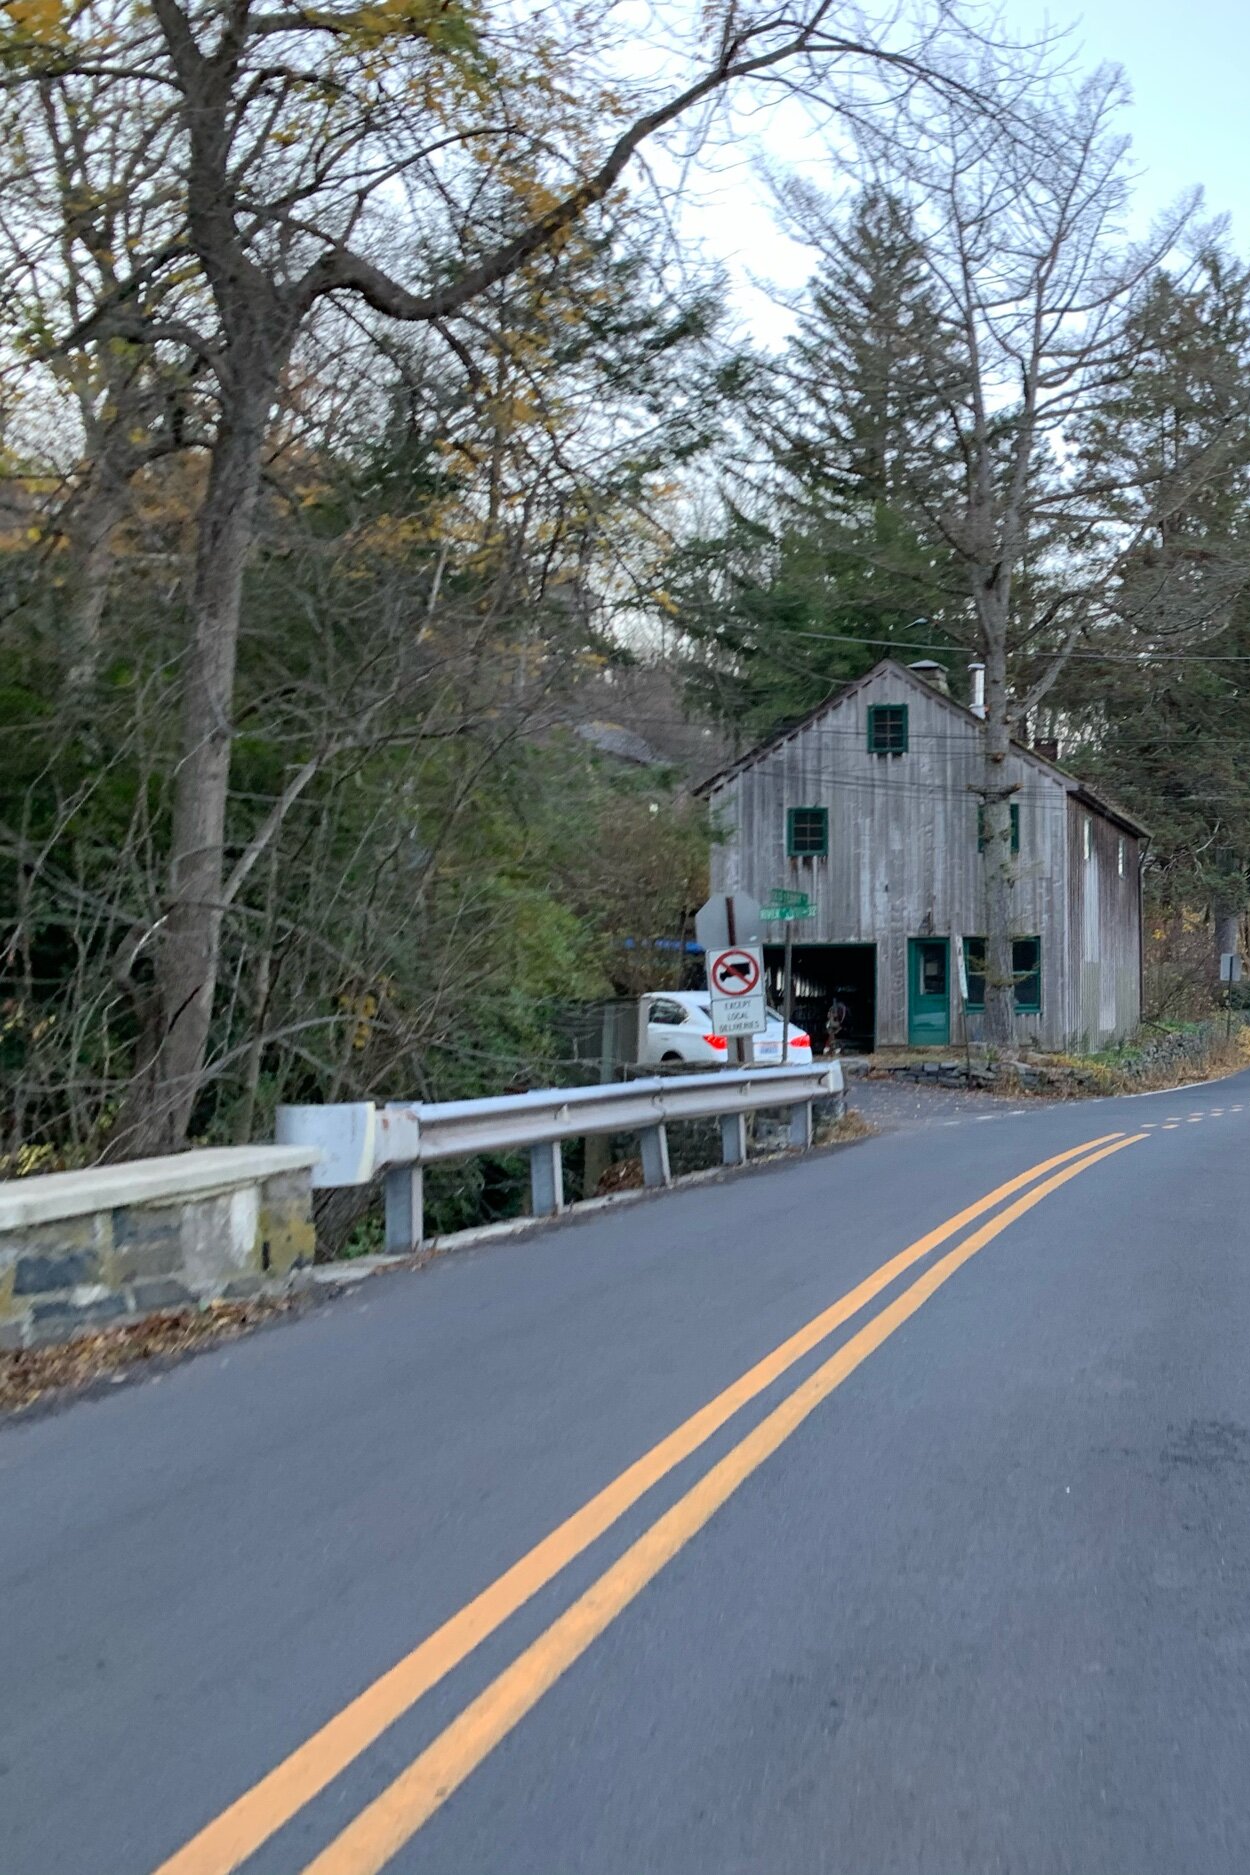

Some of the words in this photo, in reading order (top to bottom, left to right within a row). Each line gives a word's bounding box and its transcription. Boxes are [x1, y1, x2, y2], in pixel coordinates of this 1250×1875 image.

[724, 1000, 752, 1010] EXCEPT
[727, 1011, 749, 1021] LOCAL
[719, 1020, 760, 1032] DELIVERIES
